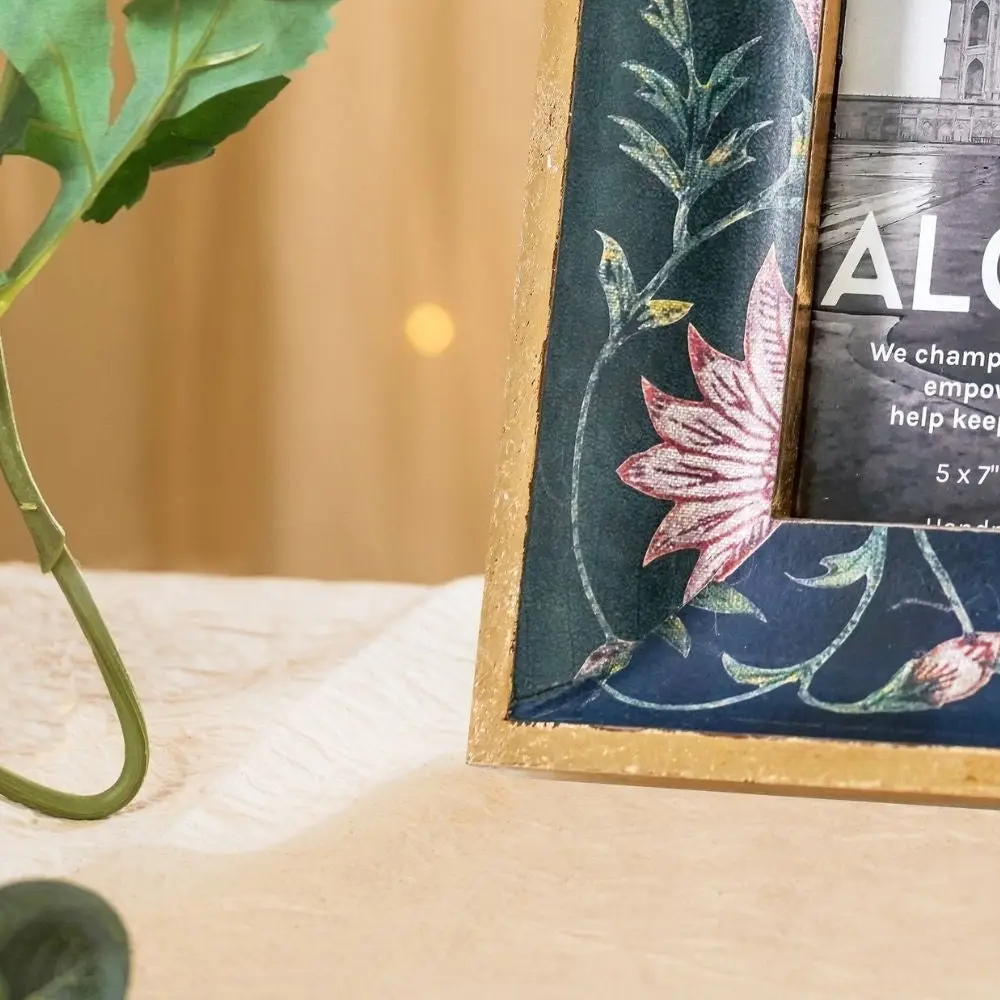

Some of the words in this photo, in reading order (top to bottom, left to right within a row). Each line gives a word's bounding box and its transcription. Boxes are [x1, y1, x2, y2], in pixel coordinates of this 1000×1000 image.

[870, 342, 907, 364] We
[889, 404, 944, 434] help
[935, 463, 949, 483] 5
[956, 467, 971, 484] x
[977, 464, 1000, 485] 7"
